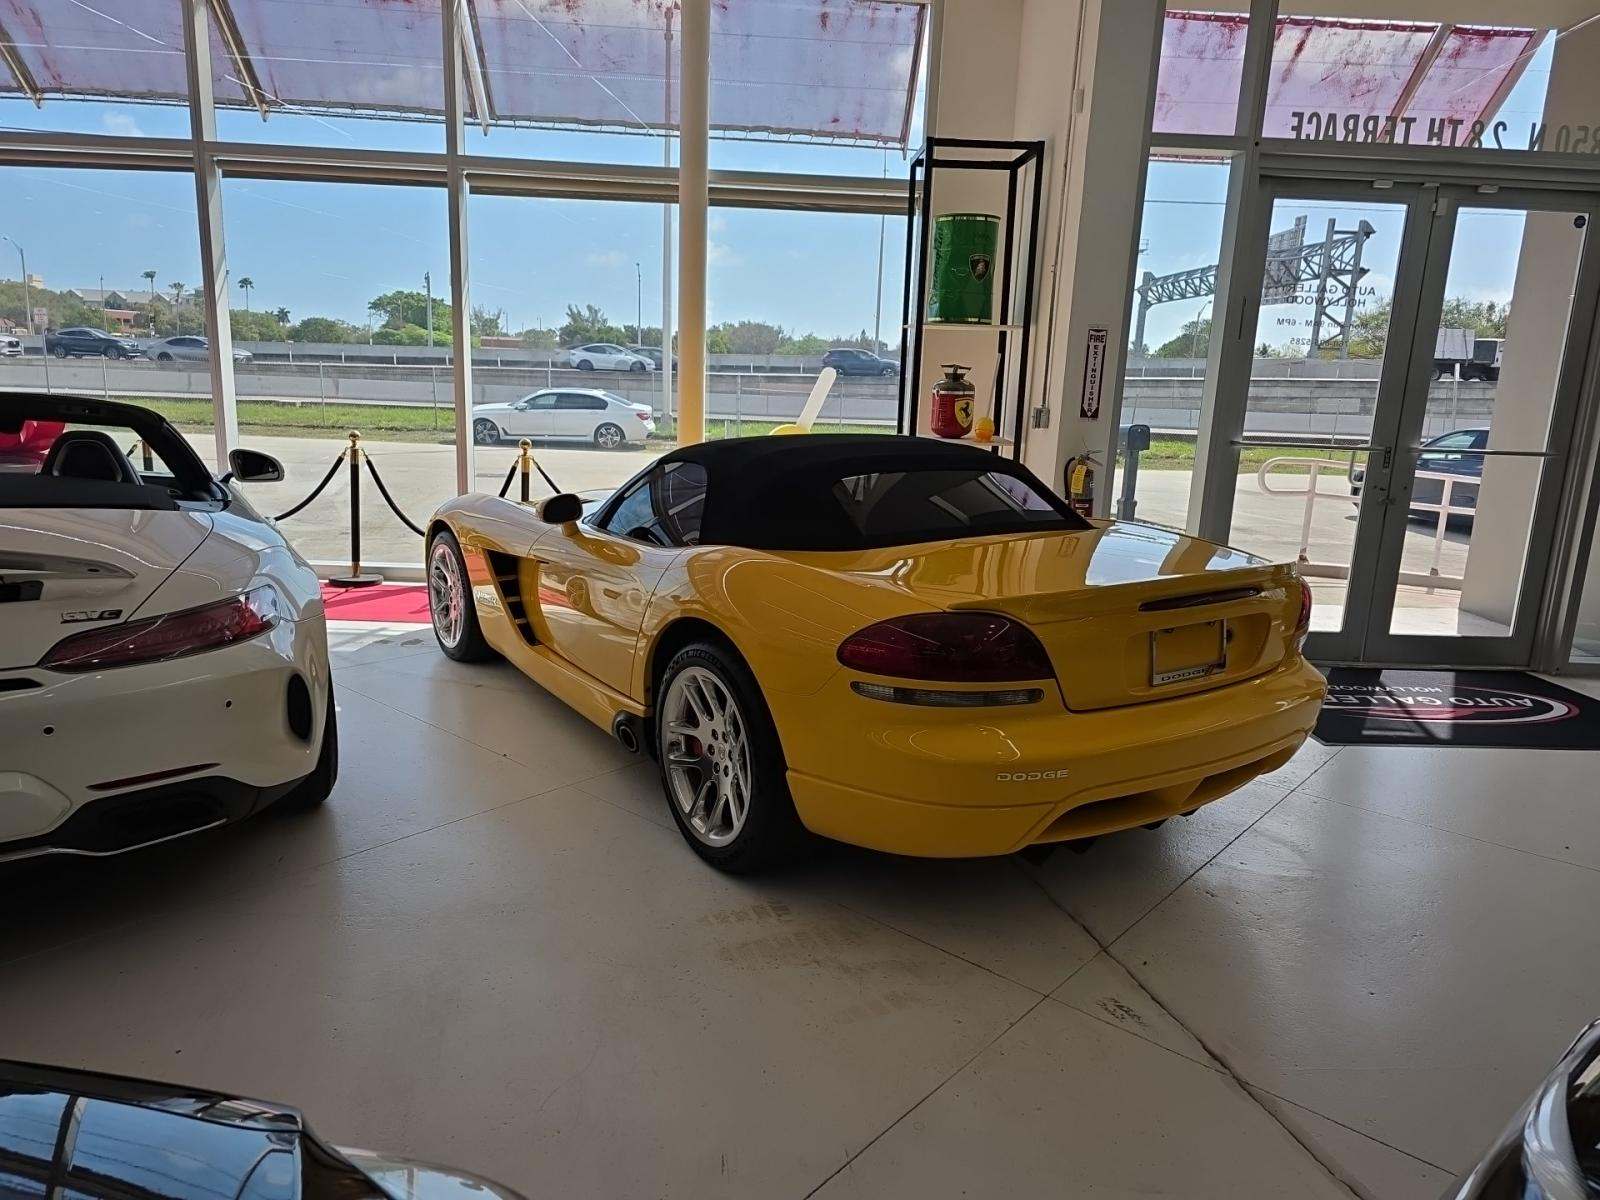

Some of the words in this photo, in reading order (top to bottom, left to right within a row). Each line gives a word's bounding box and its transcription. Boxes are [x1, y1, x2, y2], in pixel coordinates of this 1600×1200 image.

[1089, 334, 1106, 343] FIRE
[1087, 344, 1101, 414] EXTINGUISHER
[1450, 696, 1532, 707] AUTO
[996, 769, 1070, 781] DODGE
